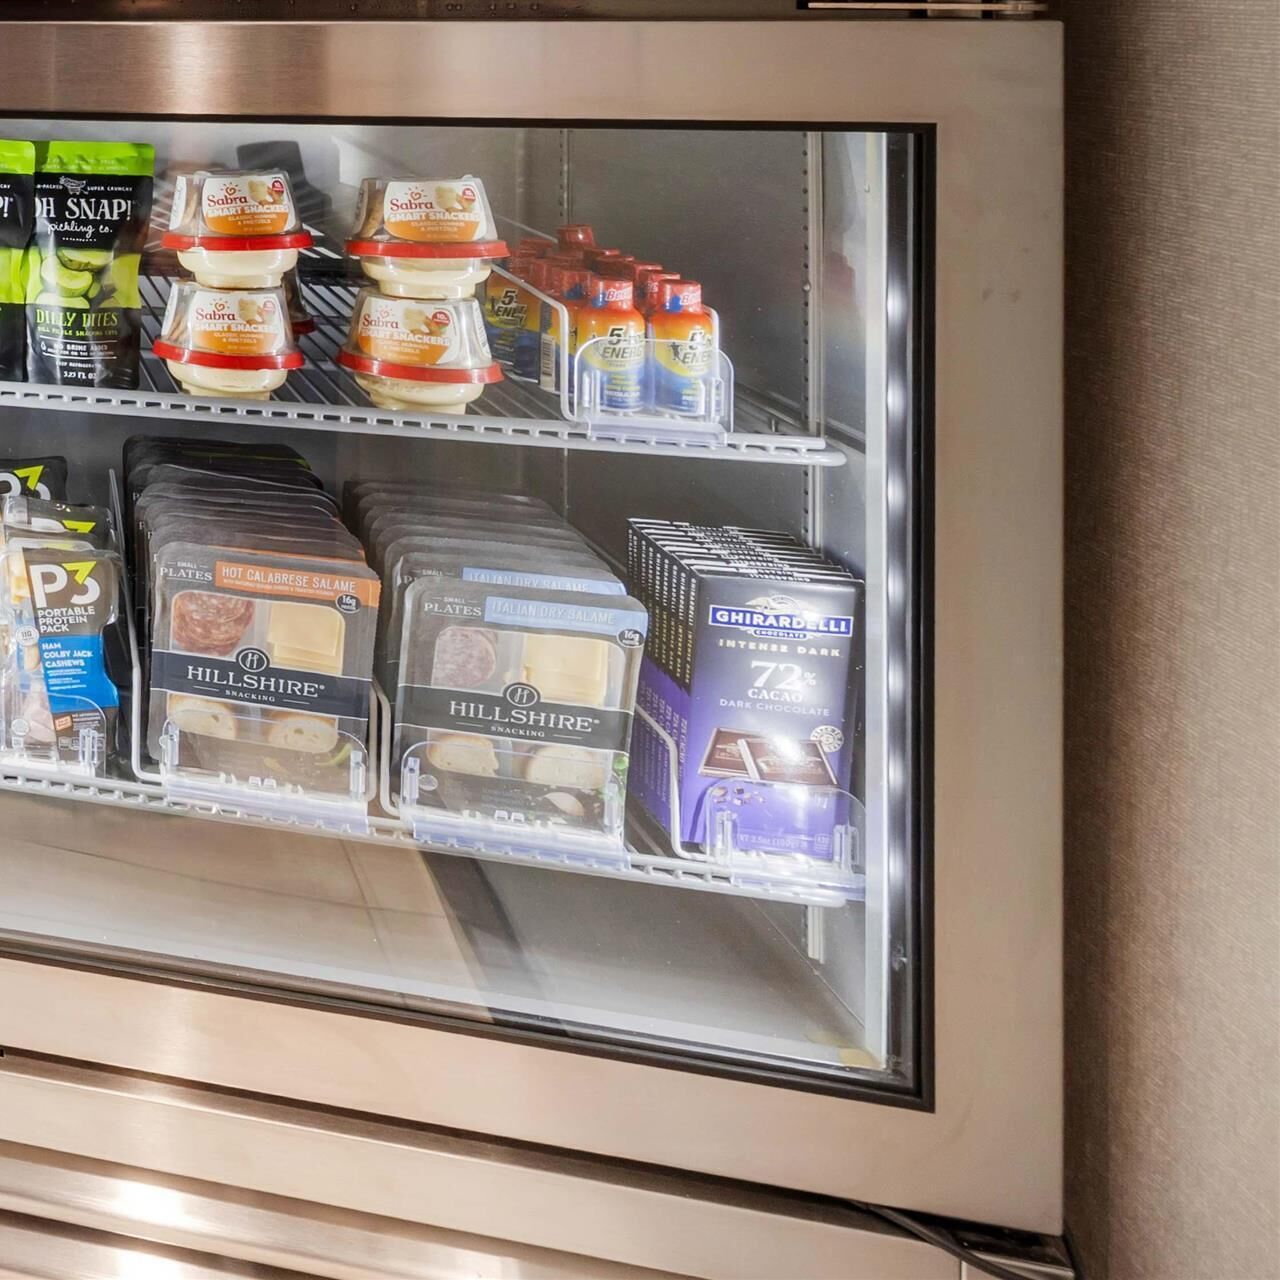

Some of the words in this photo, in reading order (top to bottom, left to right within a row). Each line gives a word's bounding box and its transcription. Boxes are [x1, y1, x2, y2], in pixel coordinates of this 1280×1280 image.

[207, 194, 248, 208] Sabra
[390, 199, 435, 212] Sabra
[65, 198, 132, 221] SNAP!
[208, 206, 243, 217] SMART
[390, 212, 426, 222] SMART
[47, 220, 96, 238] pickling
[99, 224, 113, 233] co.
[36, 308, 77, 327] DILLY
[195, 308, 236, 321] Sabra
[362, 313, 399, 329] Sabra
[177, 561, 198, 569] SMALL
[159, 566, 214, 582] PLATES
[221, 567, 244, 580] HOT
[246, 568, 311, 587] CALABRESE
[312, 576, 357, 594] SALAME
[29, 561, 101, 609] P3
[443, 596, 467, 604] SMALL
[37, 605, 96, 618] PORTABLE
[424, 602, 482, 617] PLATES
[491, 600, 538, 617] ITALIAN
[540, 606, 566, 620] DRY
[567, 608, 617, 625] SALAME
[39, 615, 88, 626] PROTEIN
[716, 610, 848, 633] GHIRARDELLI
[40, 623, 70, 634] PACK
[756, 630, 805, 639] CHOCOLATE
[42, 642, 62, 650] HAM
[718, 639, 789, 653] INTENSE
[797, 646, 841, 657] DARK
[44, 650, 71, 659] COLBY
[73, 650, 94, 658] JACK
[45, 659, 86, 669] CASHEWS
[187, 664, 320, 699] HILLSHIRE
[751, 660, 817, 691] 72%
[225, 689, 276, 702] SNACKING
[747, 688, 804, 703] CACAO
[719, 699, 753, 709] DARK
[756, 702, 830, 717] CHOCOLATE
[449, 700, 593, 732] HILLSHIRE
[491, 726, 546, 738] SNACKING
